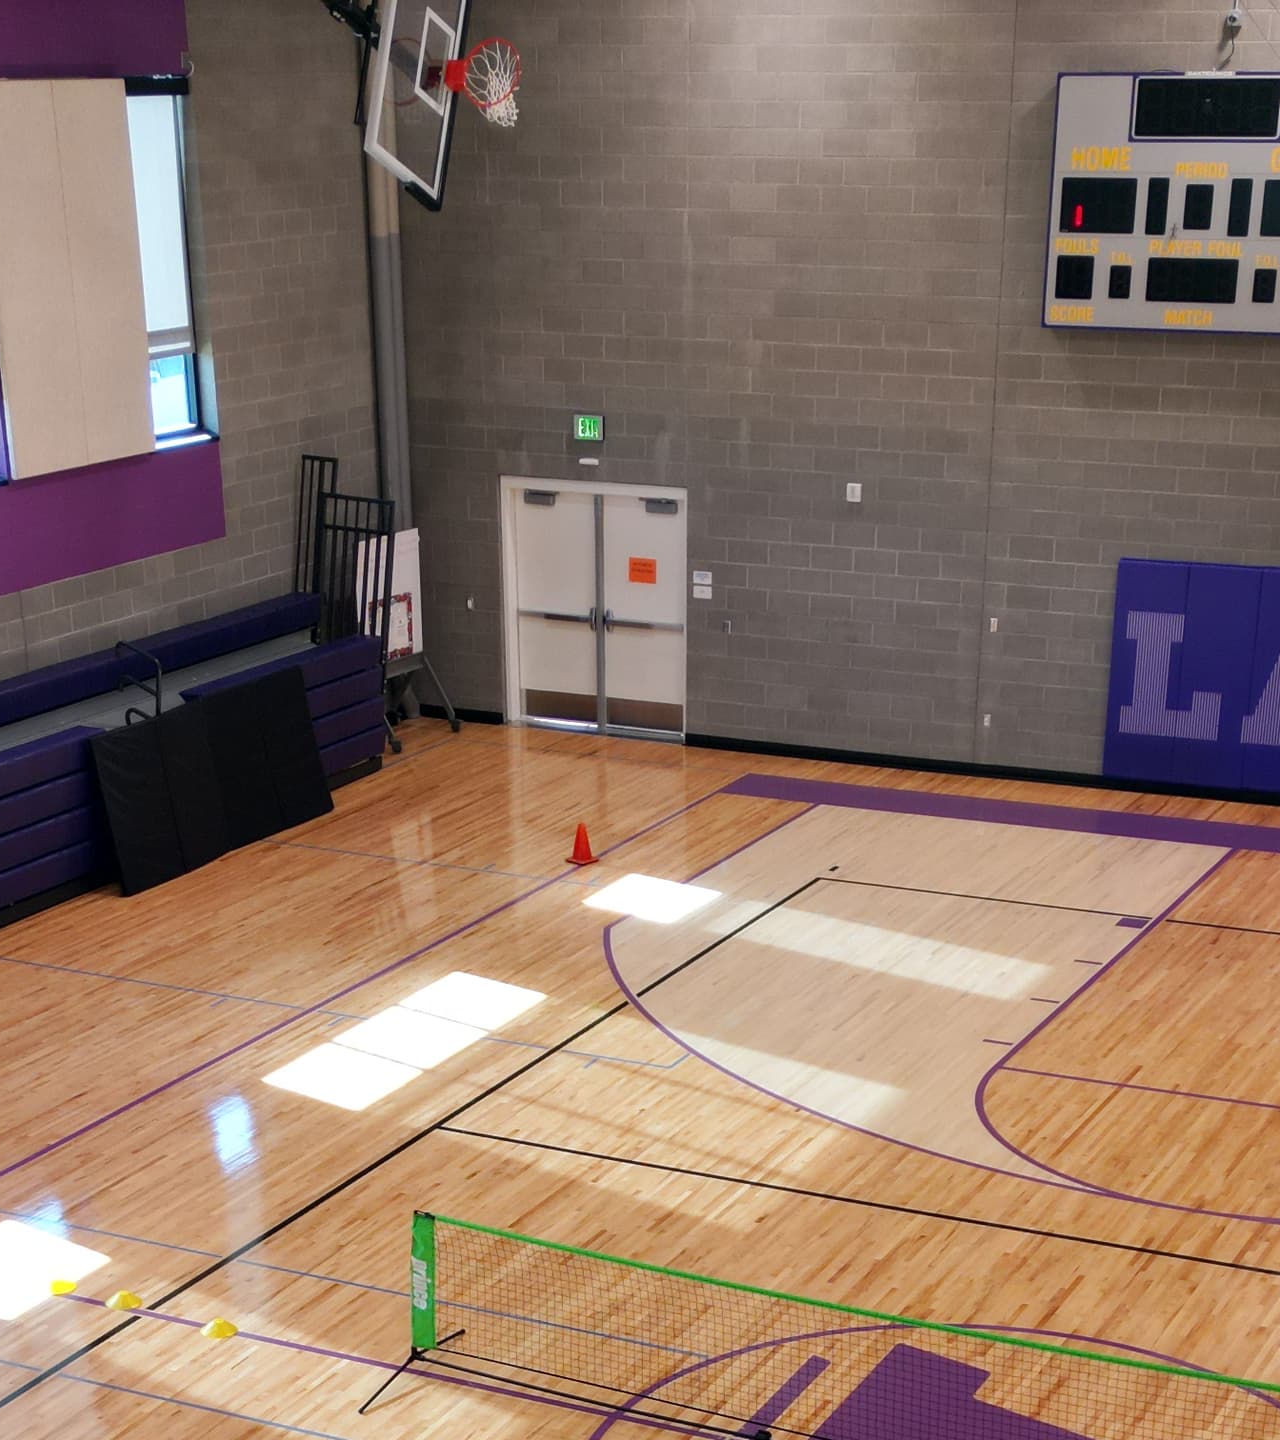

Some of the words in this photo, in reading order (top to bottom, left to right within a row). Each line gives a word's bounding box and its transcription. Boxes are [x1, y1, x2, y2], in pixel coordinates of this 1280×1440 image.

[1071, 146, 1132, 171] HOME
[1175, 162, 1228, 179] PERIOD
[1055, 238, 1099, 255] FOULS
[1149, 240, 1202, 257] PLAYER
[1050, 305, 1094, 322] SCORE
[1164, 309, 1213, 327] MATCH
[411, 1256, 432, 1310] prince
